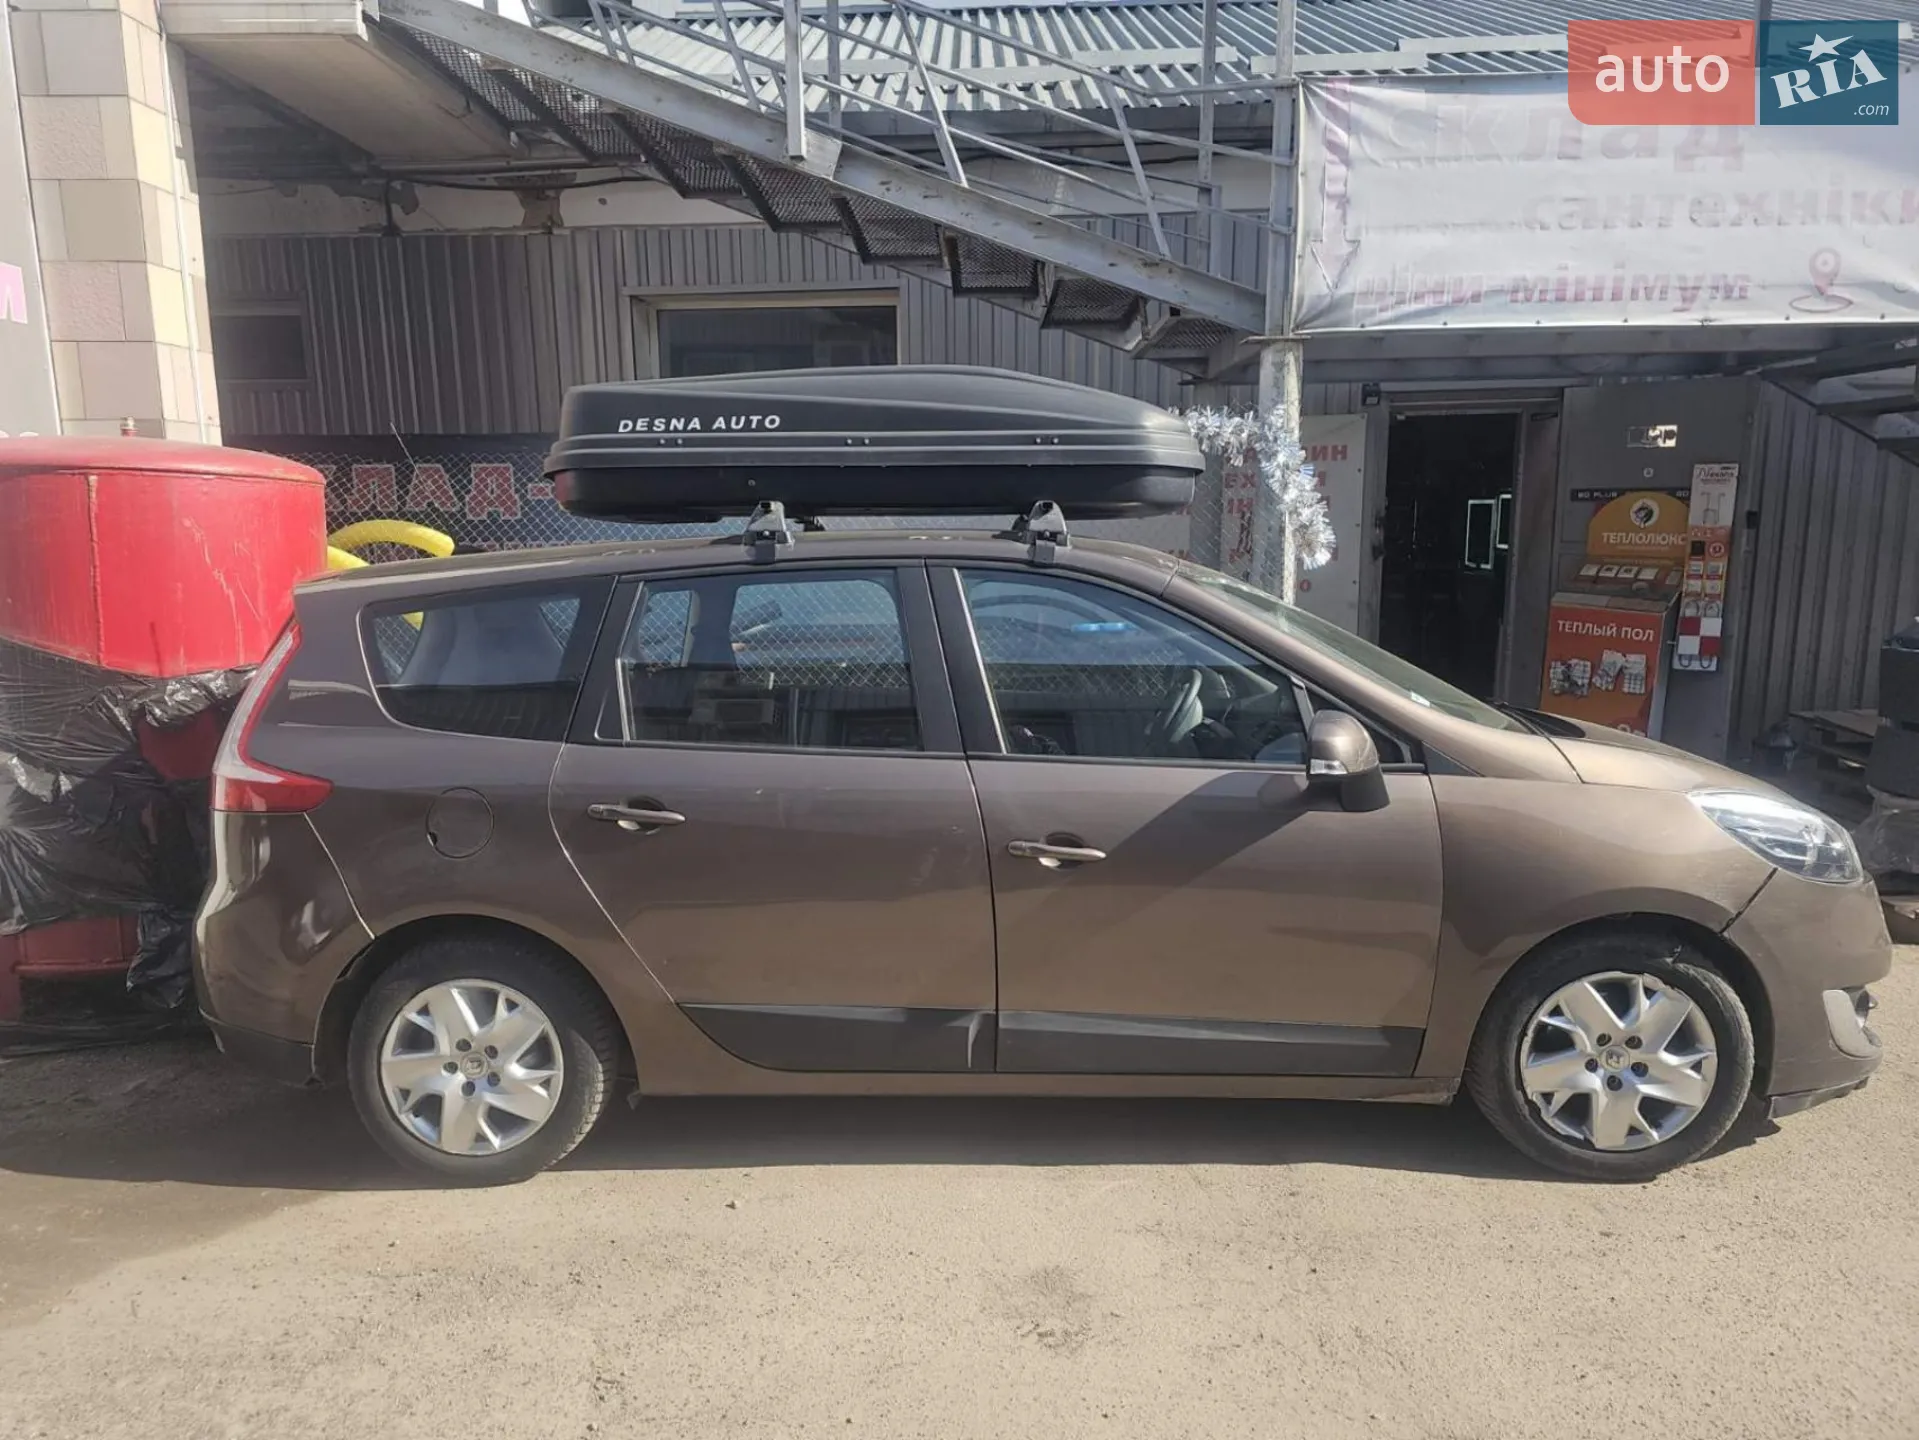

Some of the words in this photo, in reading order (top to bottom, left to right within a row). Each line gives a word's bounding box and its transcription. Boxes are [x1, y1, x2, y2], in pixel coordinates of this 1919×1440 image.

[617, 417, 702, 433] DESNA
[712, 414, 781, 431] AUTO
[1557, 619, 1617, 638] ТЕПЛЫЙ
[1620, 626, 1654, 642] ПОЛ
